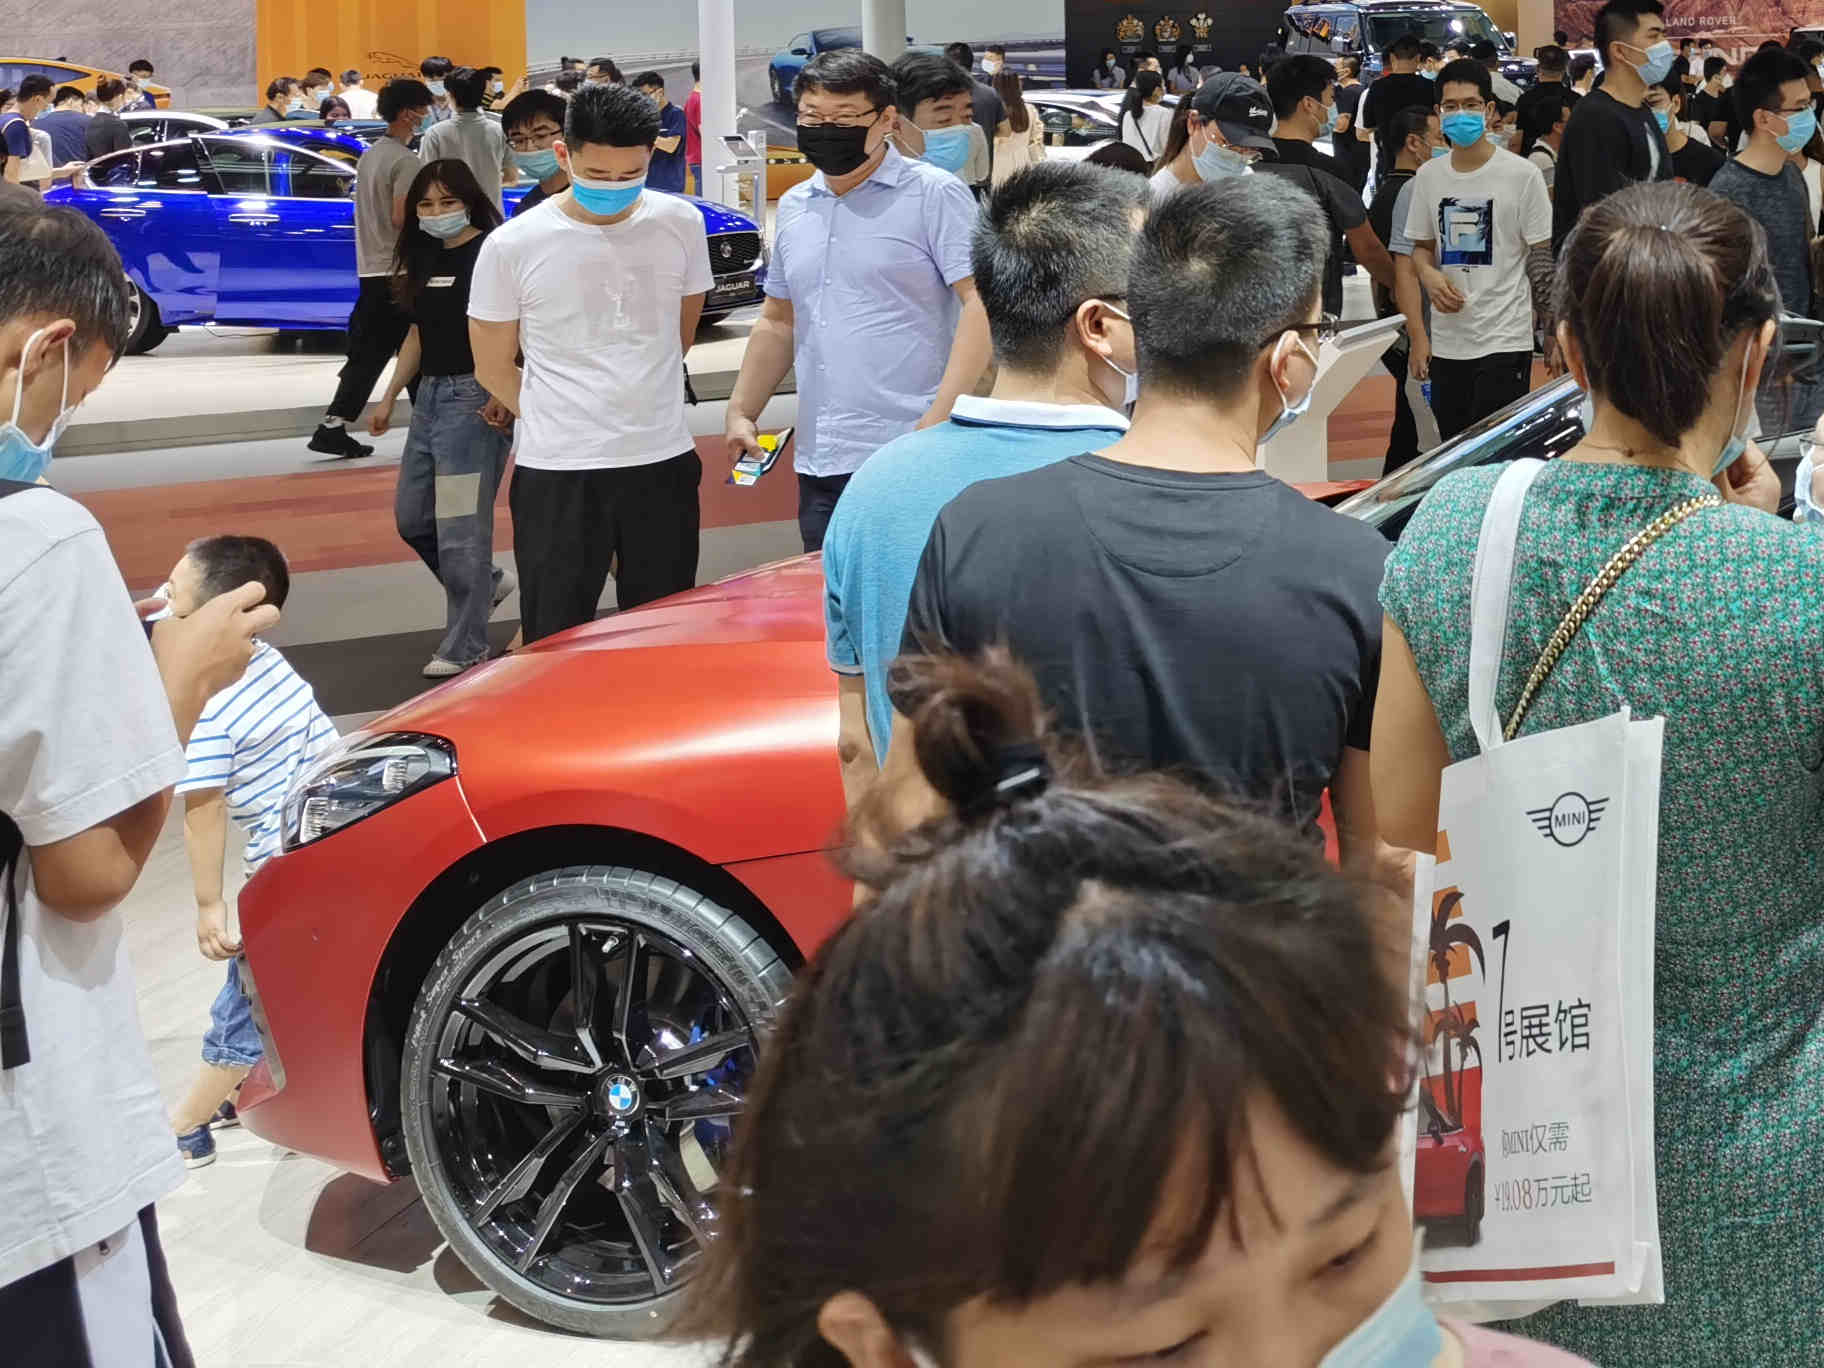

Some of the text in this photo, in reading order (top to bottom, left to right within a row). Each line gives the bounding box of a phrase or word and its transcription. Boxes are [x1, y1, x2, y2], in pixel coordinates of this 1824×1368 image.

[1665, 16, 1737, 26] LAND ROVER
[1554, 810, 1586, 829] MINI
[1492, 919, 1592, 1064] 7号展馆
